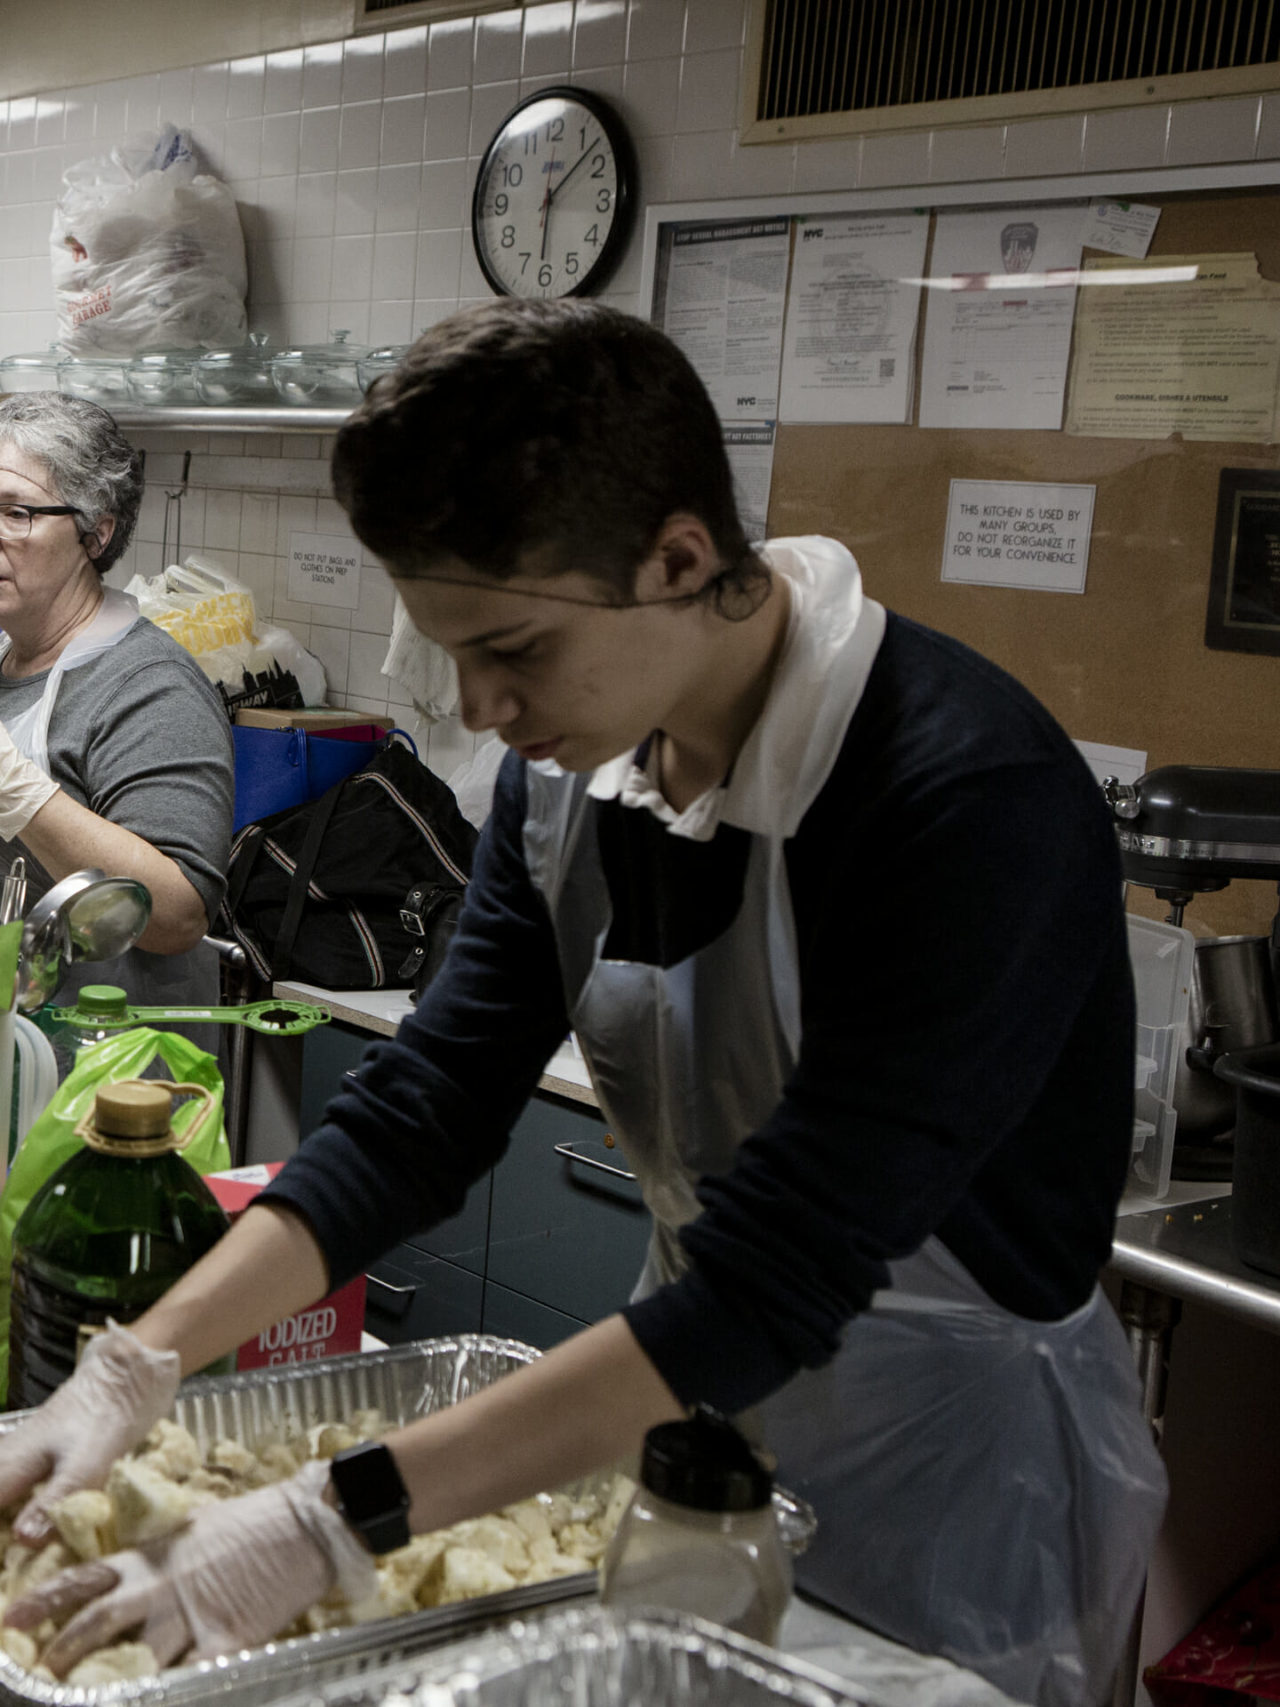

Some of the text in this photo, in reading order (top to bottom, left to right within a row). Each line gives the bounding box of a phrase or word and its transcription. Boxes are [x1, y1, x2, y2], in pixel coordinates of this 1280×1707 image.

[546, 118, 565, 142] 12
[579, 127, 586, 150] 1
[524, 131, 538, 155] 11
[503, 163, 523, 187] 10
[591, 154, 605, 179] 2
[494, 194, 509, 216] 9
[596, 188, 611, 213] 3
[501, 225, 515, 249] 8
[583, 223, 599, 247] 4
[803, 228, 824, 238] NYC
[519, 252, 532, 275] 7
[565, 252, 579, 275] 5
[538, 264, 552, 287] 6
[737, 397, 756, 406] NYC
[960, 504, 1080, 521] THIS KITCHEN IS USED BY
[980, 520, 1057, 535] MANY GROUPS,
[953, 545, 971, 556] FOR
[977, 547, 1001, 559] YOUR
[958, 532, 1076, 549] DO NOT REORGANIZE IT
[294, 552, 356, 567] DO NOT PUT BAGS AND
[301, 562, 323, 573] CLOTHES
[335, 567, 347, 576] PREP
[259, 1306, 337, 1353] IODIZED
